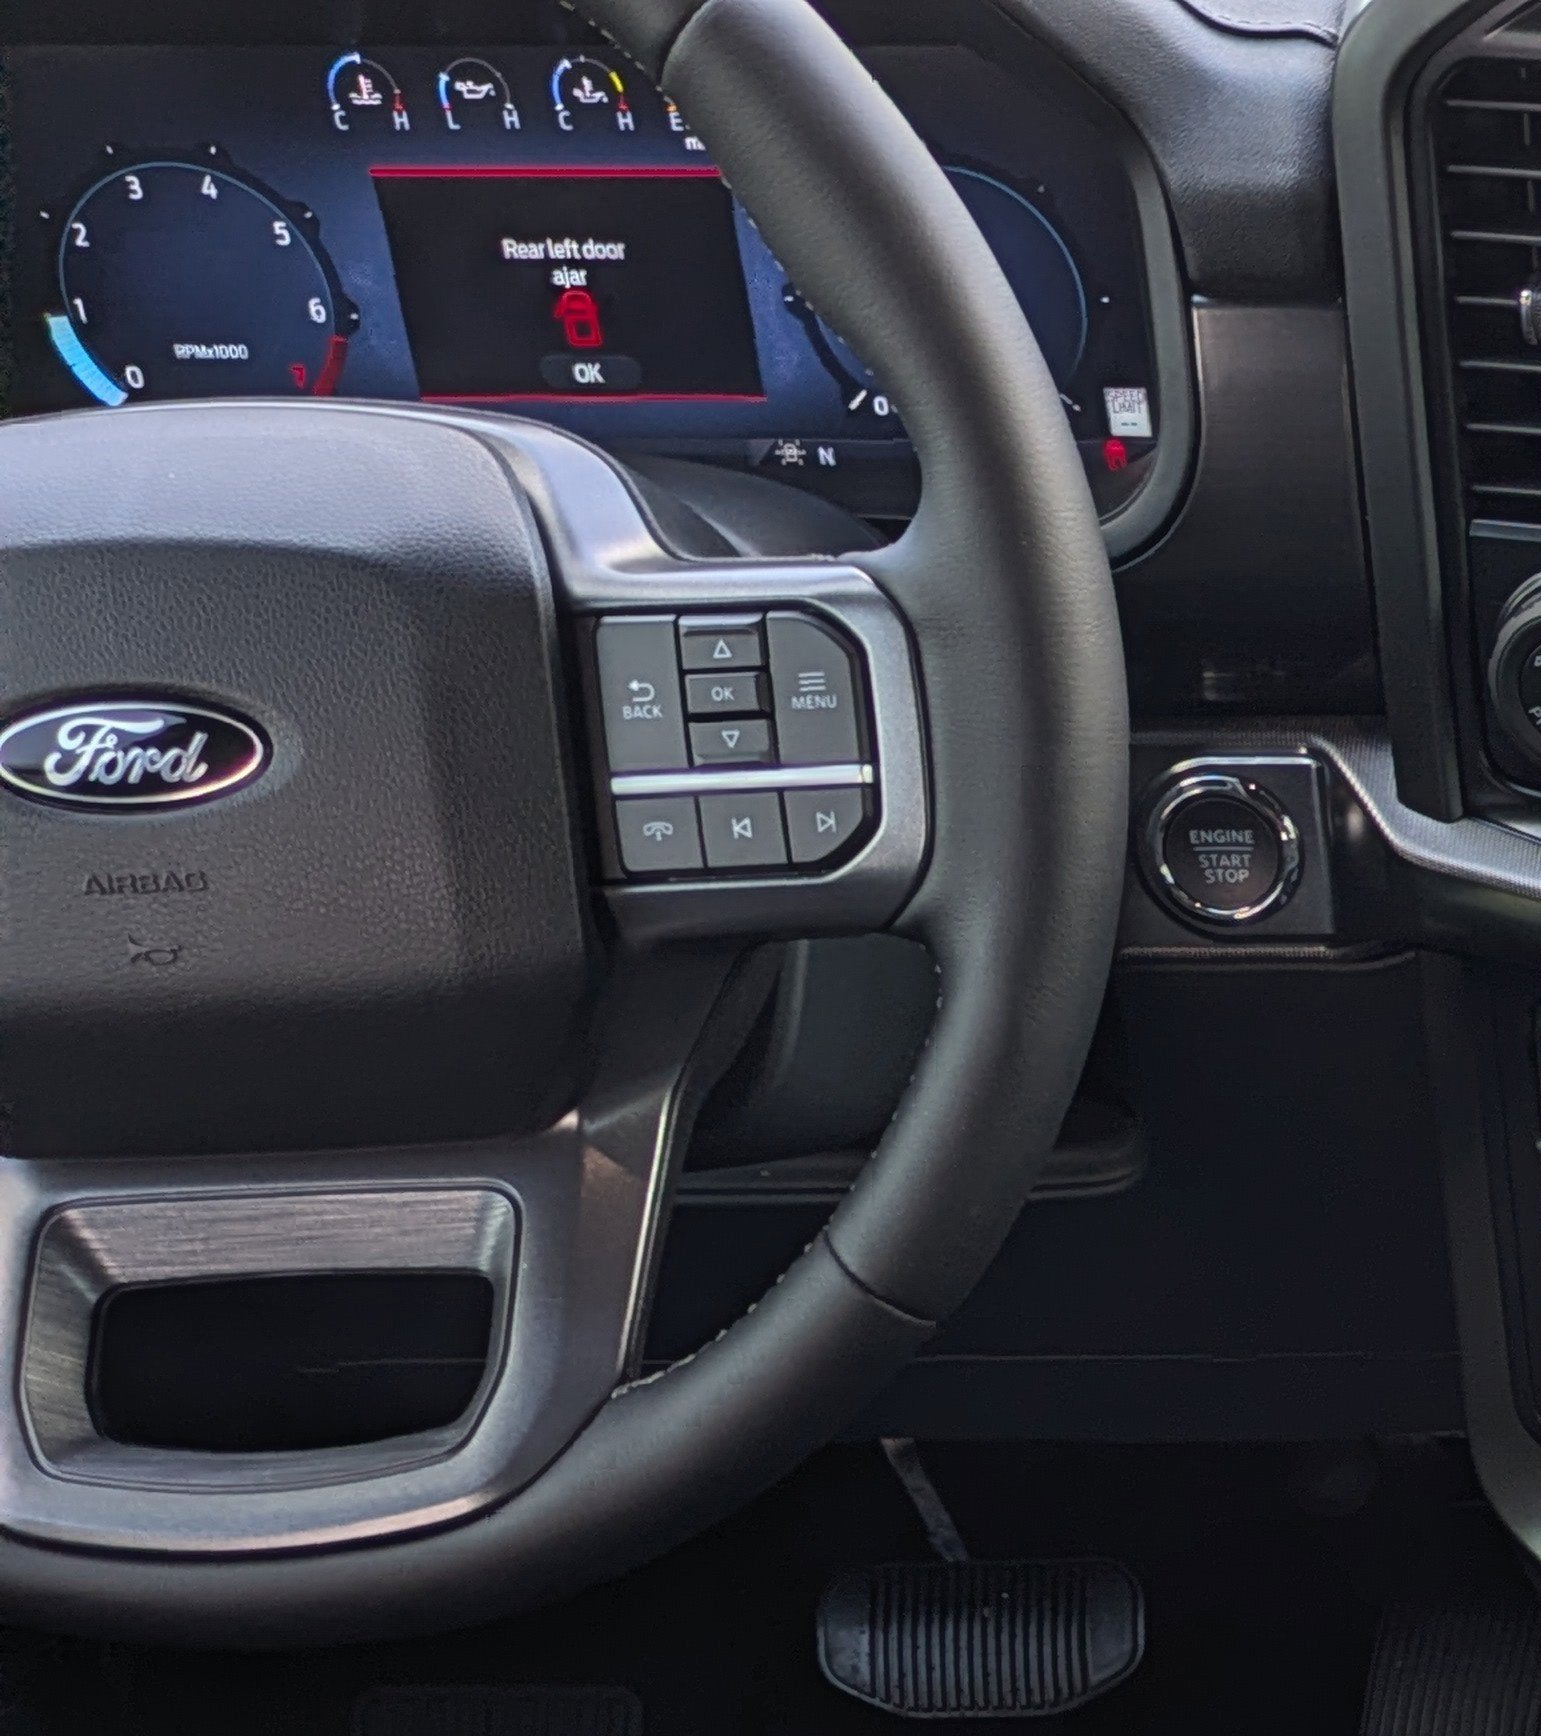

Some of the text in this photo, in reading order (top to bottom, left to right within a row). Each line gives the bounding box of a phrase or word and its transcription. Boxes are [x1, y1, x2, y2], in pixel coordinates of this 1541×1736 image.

[333, 110, 350, 131] C
[393, 110, 411, 131] H
[446, 110, 461, 131] L
[503, 109, 521, 130] H
[557, 110, 574, 131] C
[616, 110, 635, 131] H
[669, 111, 684, 131] E
[124, 174, 144, 201] 3
[200, 174, 218, 200] 4
[71, 222, 90, 248] 2
[271, 221, 292, 246] 5
[501, 236, 626, 261] Rear left door
[551, 265, 588, 289] ajar
[72, 297, 88, 324] 1
[307, 297, 327, 324] 6
[124, 364, 145, 389] 0
[573, 362, 606, 384] OK
[872, 395, 890, 417] 0
[817, 446, 837, 467] N
[710, 686, 735, 701] OK
[790, 694, 838, 711] MENU
[622, 706, 663, 721] BACK
[44, 715, 208, 786] Ford
[1188, 829, 1256, 845] ENGINE
[1198, 853, 1251, 869] START
[84, 869, 210, 896] AIRBAG
[1203, 868, 1250, 884] STOP
